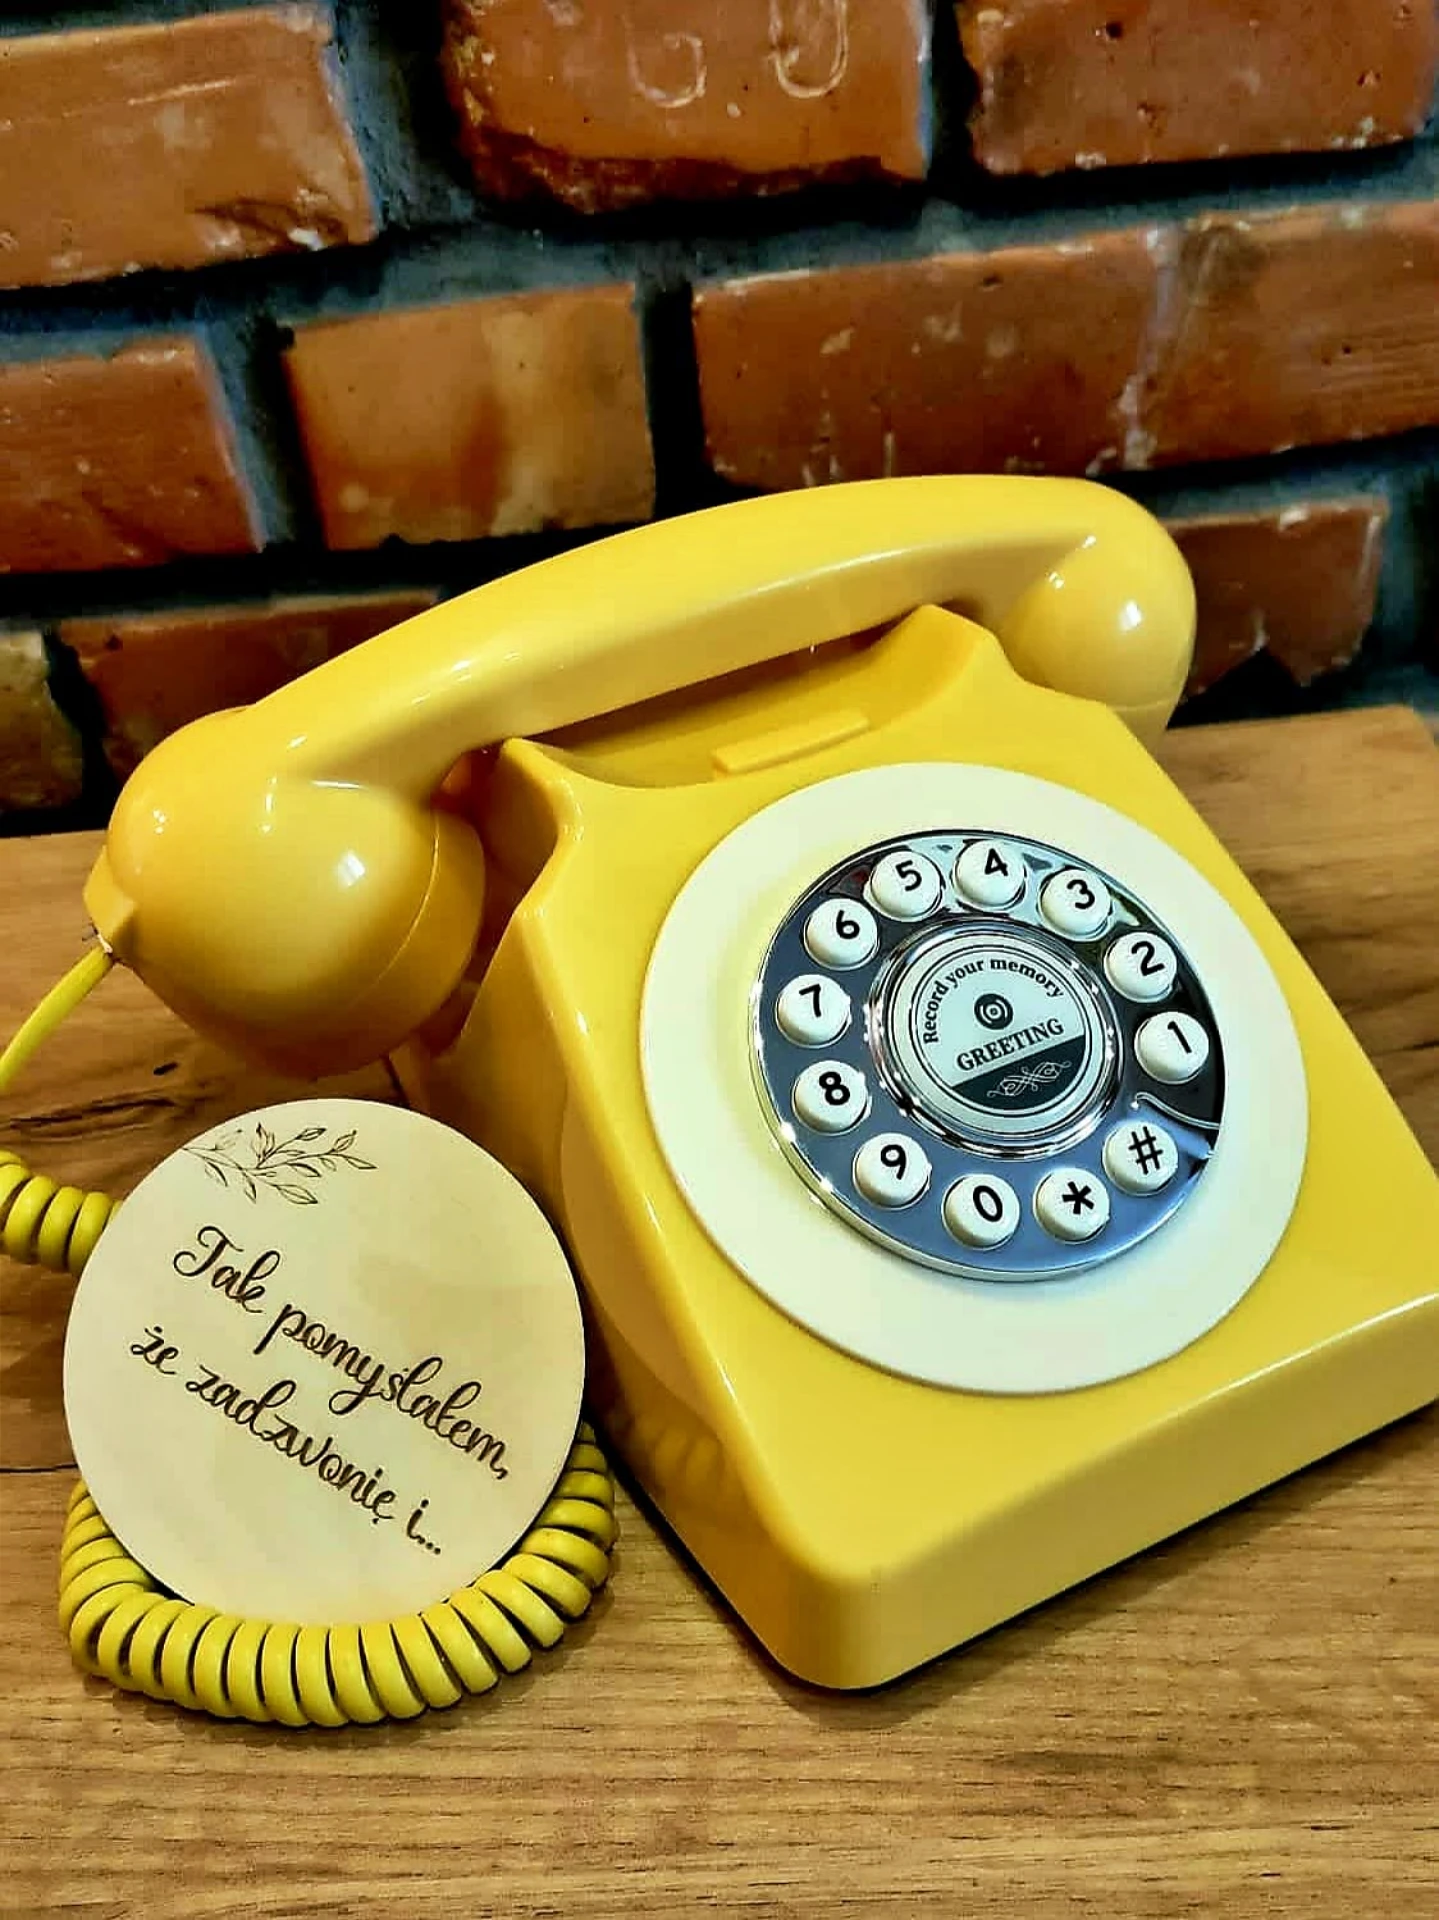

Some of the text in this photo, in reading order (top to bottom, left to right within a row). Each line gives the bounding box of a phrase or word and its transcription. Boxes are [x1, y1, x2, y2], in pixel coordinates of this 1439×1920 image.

[895, 859, 923, 892] 5
[984, 848, 1009, 877] 4
[1066, 879, 1096, 910] 3
[835, 909, 860, 940] 6
[1131, 940, 1165, 977] 2
[798, 983, 822, 1018] 7
[922, 958, 1064, 1044] Record your memory
[956, 1018, 1065, 1072] GREETING
[1167, 1020, 1192, 1054] 1
[818, 1071, 851, 1106] 8
[880, 1144, 907, 1181] 9
[1128, 1126, 1164, 1175] #
[972, 1185, 1003, 1223] 0
[173, 1225, 509, 1480] Tak pomyślałem,
[130, 1326, 441, 1555] że zadzwonię i...
